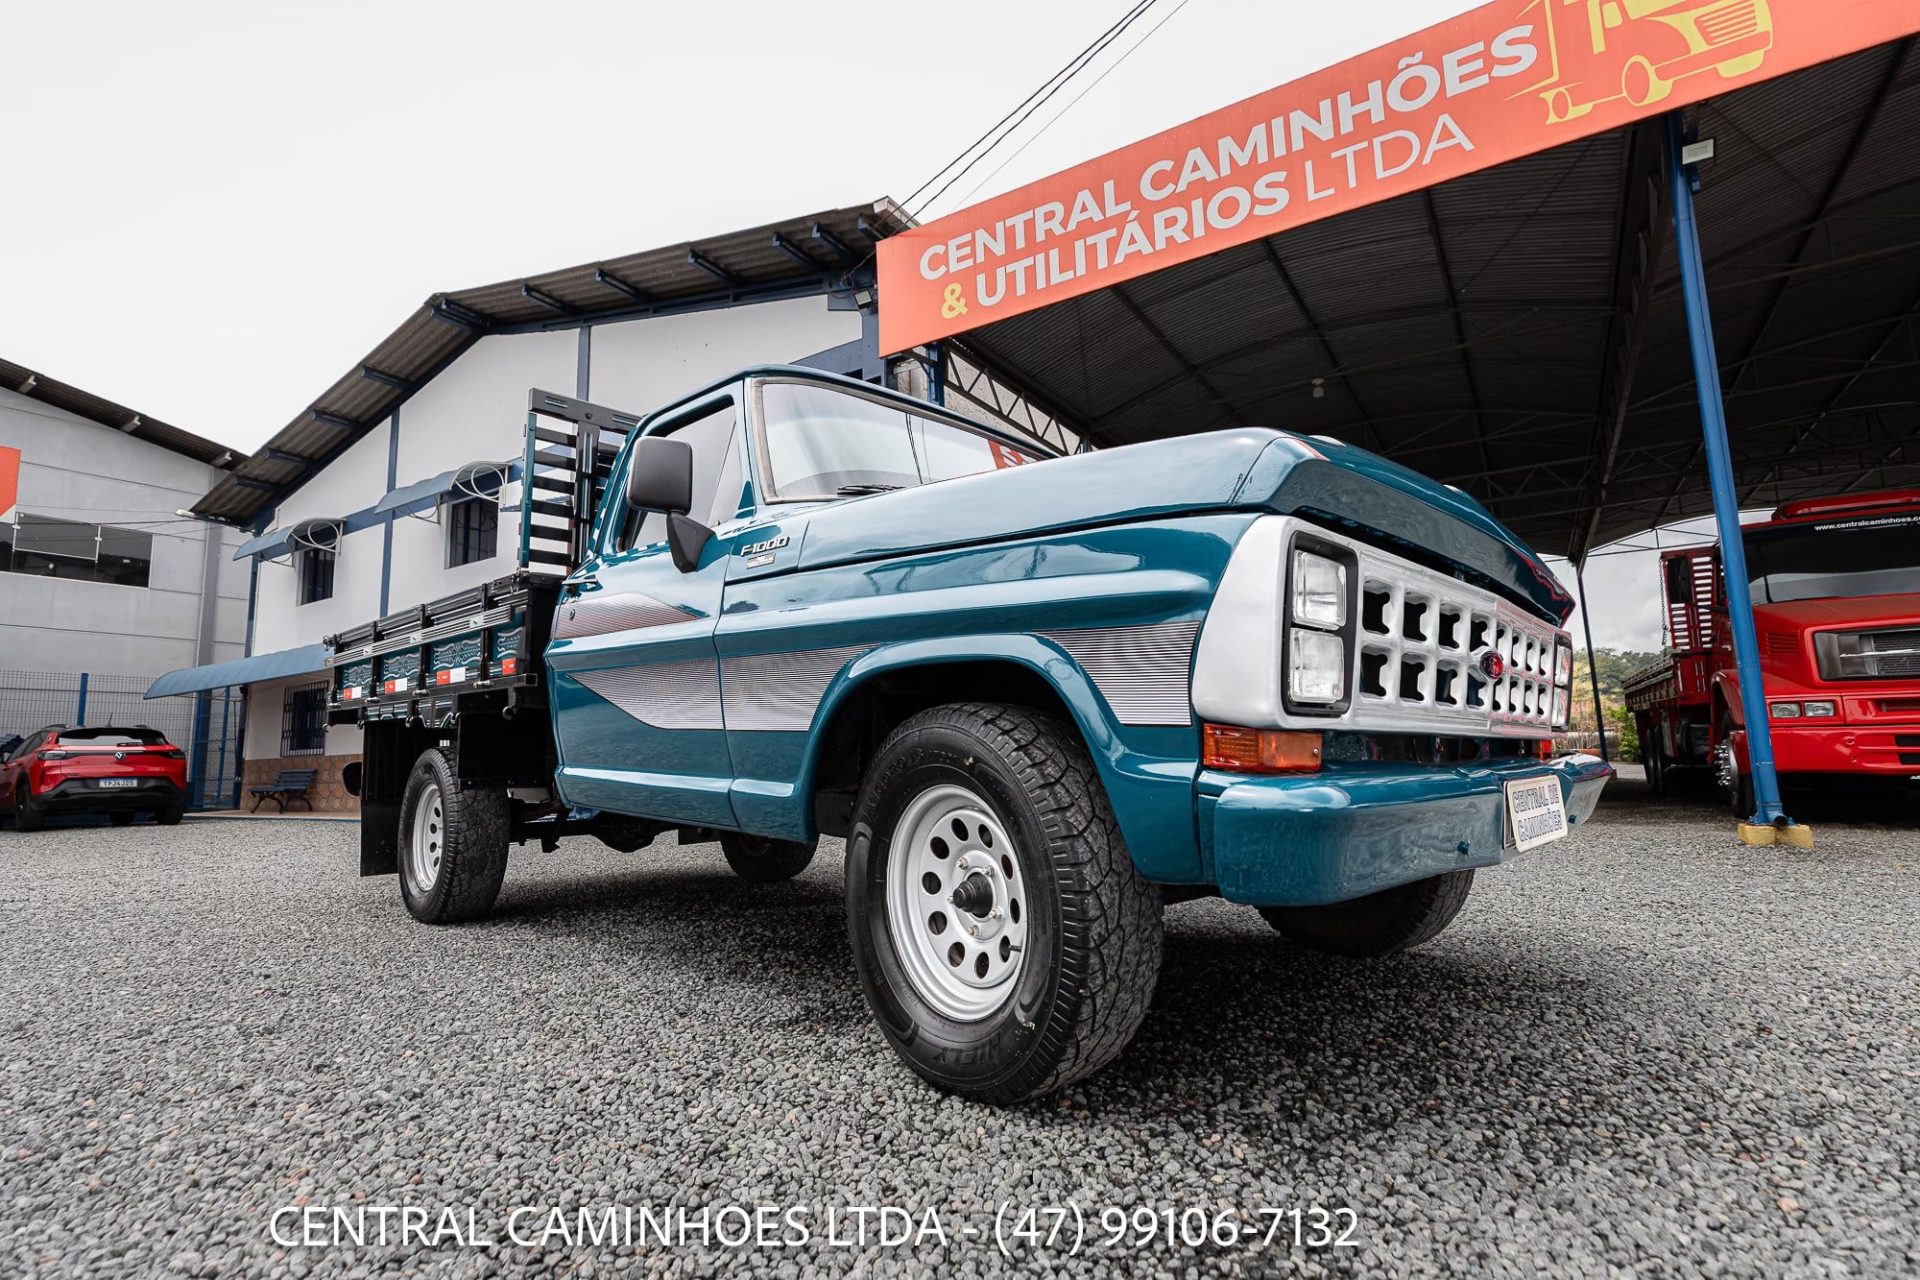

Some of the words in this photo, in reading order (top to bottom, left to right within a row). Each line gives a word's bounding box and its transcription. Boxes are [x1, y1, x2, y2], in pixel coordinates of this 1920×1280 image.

[919, 180, 1132, 280] CENTRAL
[1139, 24, 1537, 201] CAMINHÕES
[941, 282, 968, 319] &
[976, 171, 1290, 306] UTILITÁRIOS
[1305, 114, 1474, 201] LTDA
[1512, 786, 1549, 813] CENTRAL
[1548, 783, 1560, 805] DE
